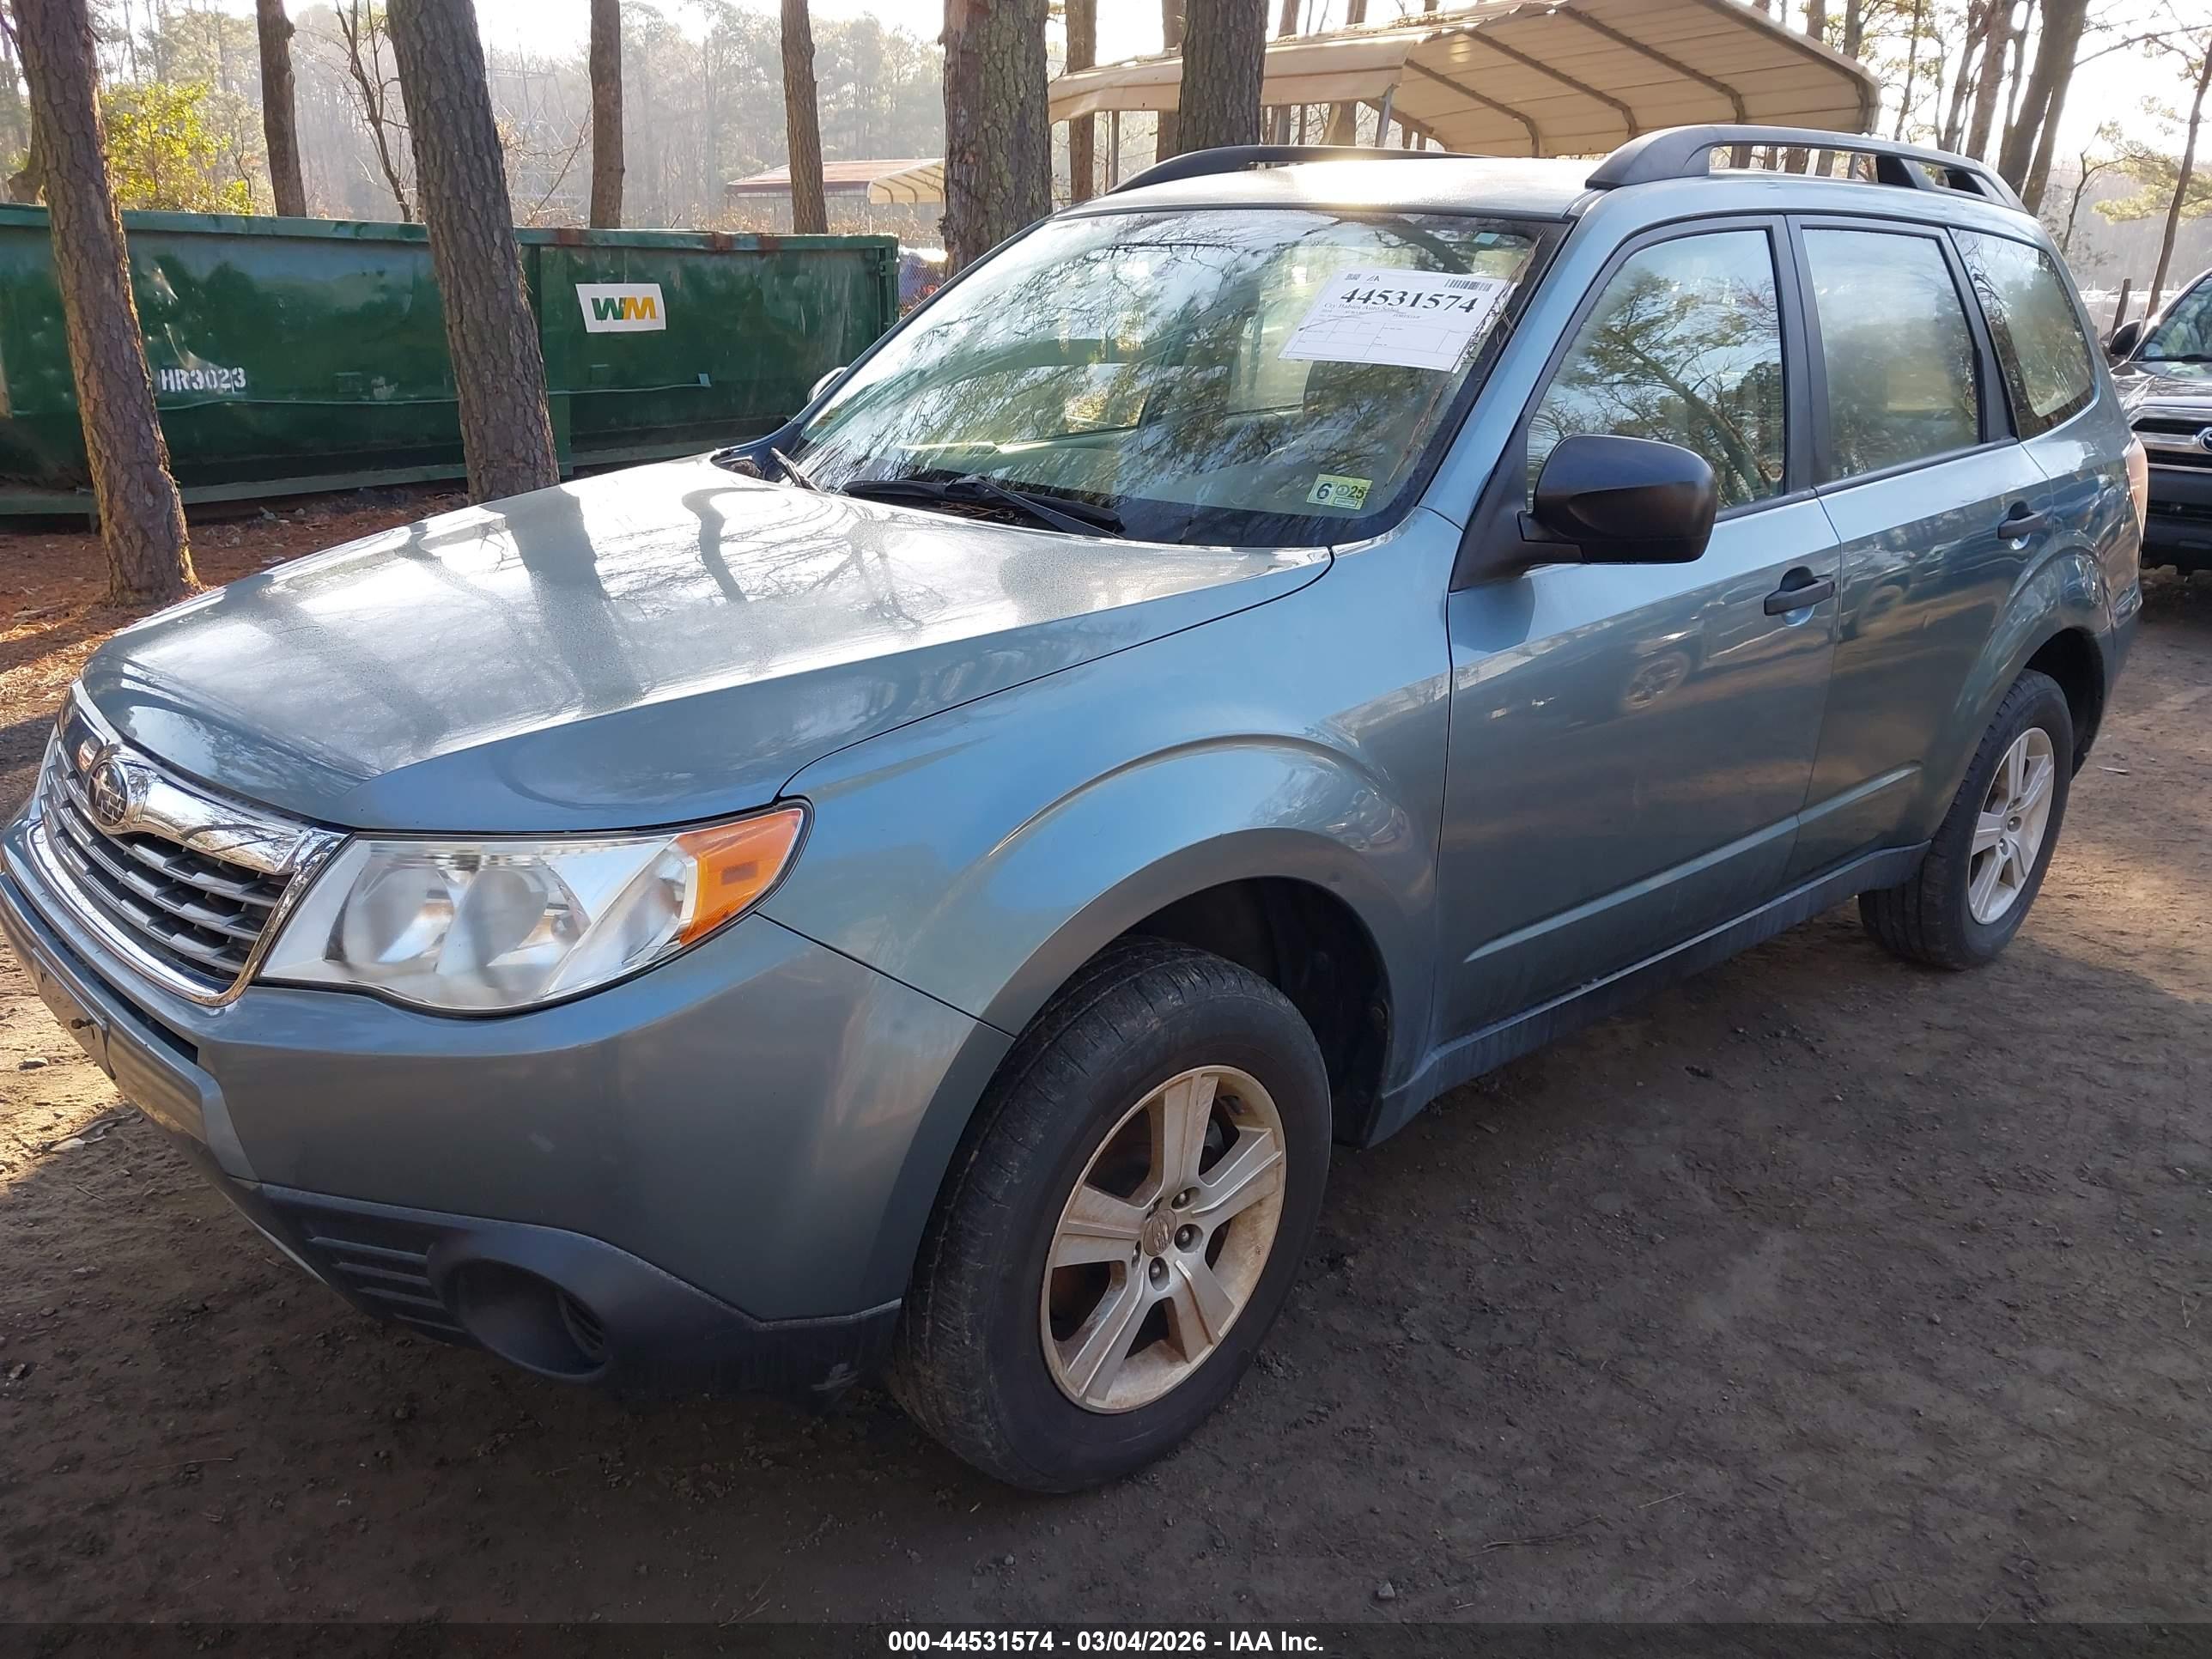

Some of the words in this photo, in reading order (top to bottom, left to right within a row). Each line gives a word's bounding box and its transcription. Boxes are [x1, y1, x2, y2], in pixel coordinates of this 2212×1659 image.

[590, 296, 657, 321] WM
[1340, 287, 1479, 313] 44531574
[159, 367, 246, 392] HR3023
[1316, 483, 1333, 500] 6
